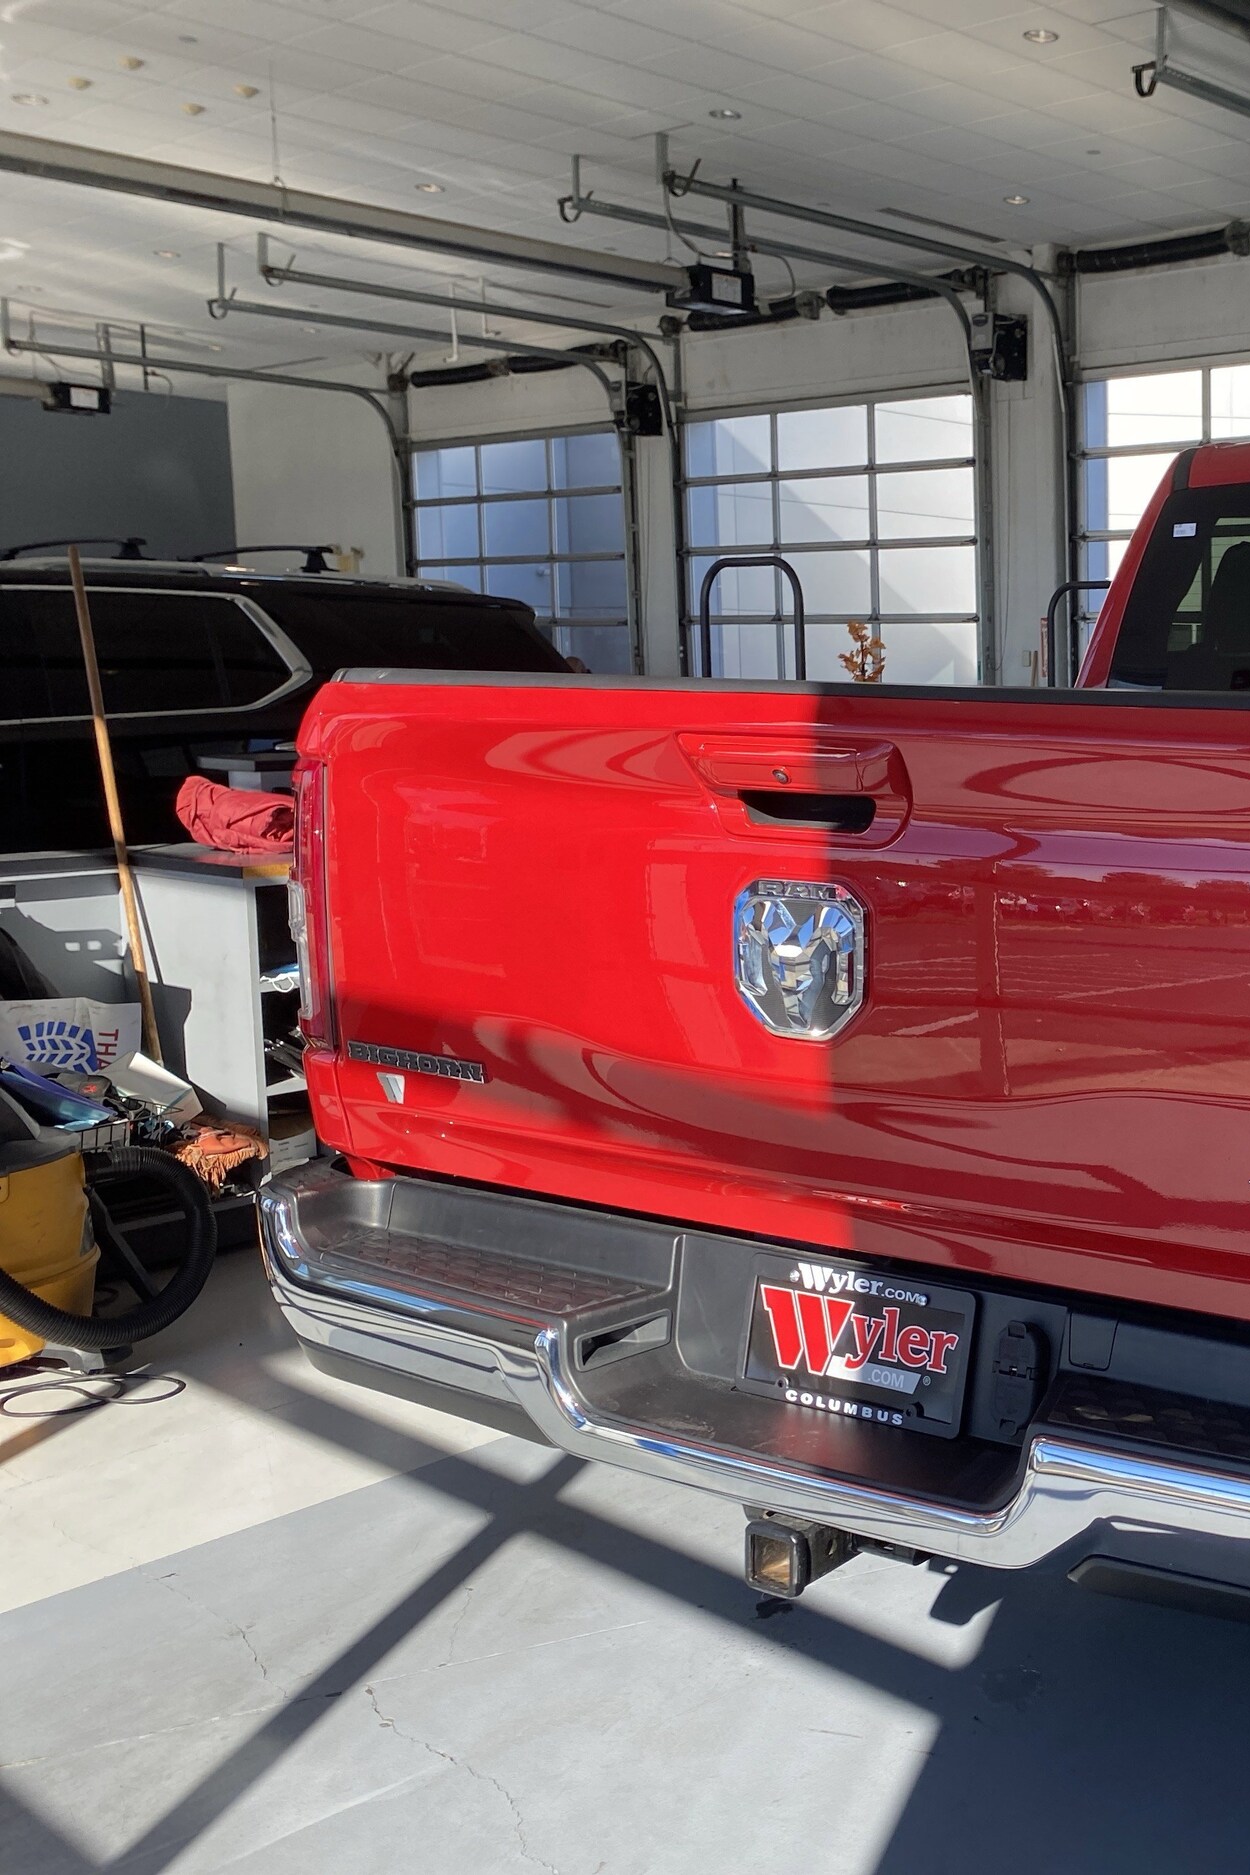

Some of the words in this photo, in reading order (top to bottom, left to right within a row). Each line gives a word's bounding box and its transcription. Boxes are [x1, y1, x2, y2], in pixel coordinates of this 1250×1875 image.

[757, 880, 837, 901] RAM
[760, 1283, 959, 1377] Wyler
[867, 1368, 905, 1389] .COM
[784, 1389, 904, 1426] COLUMBUS
